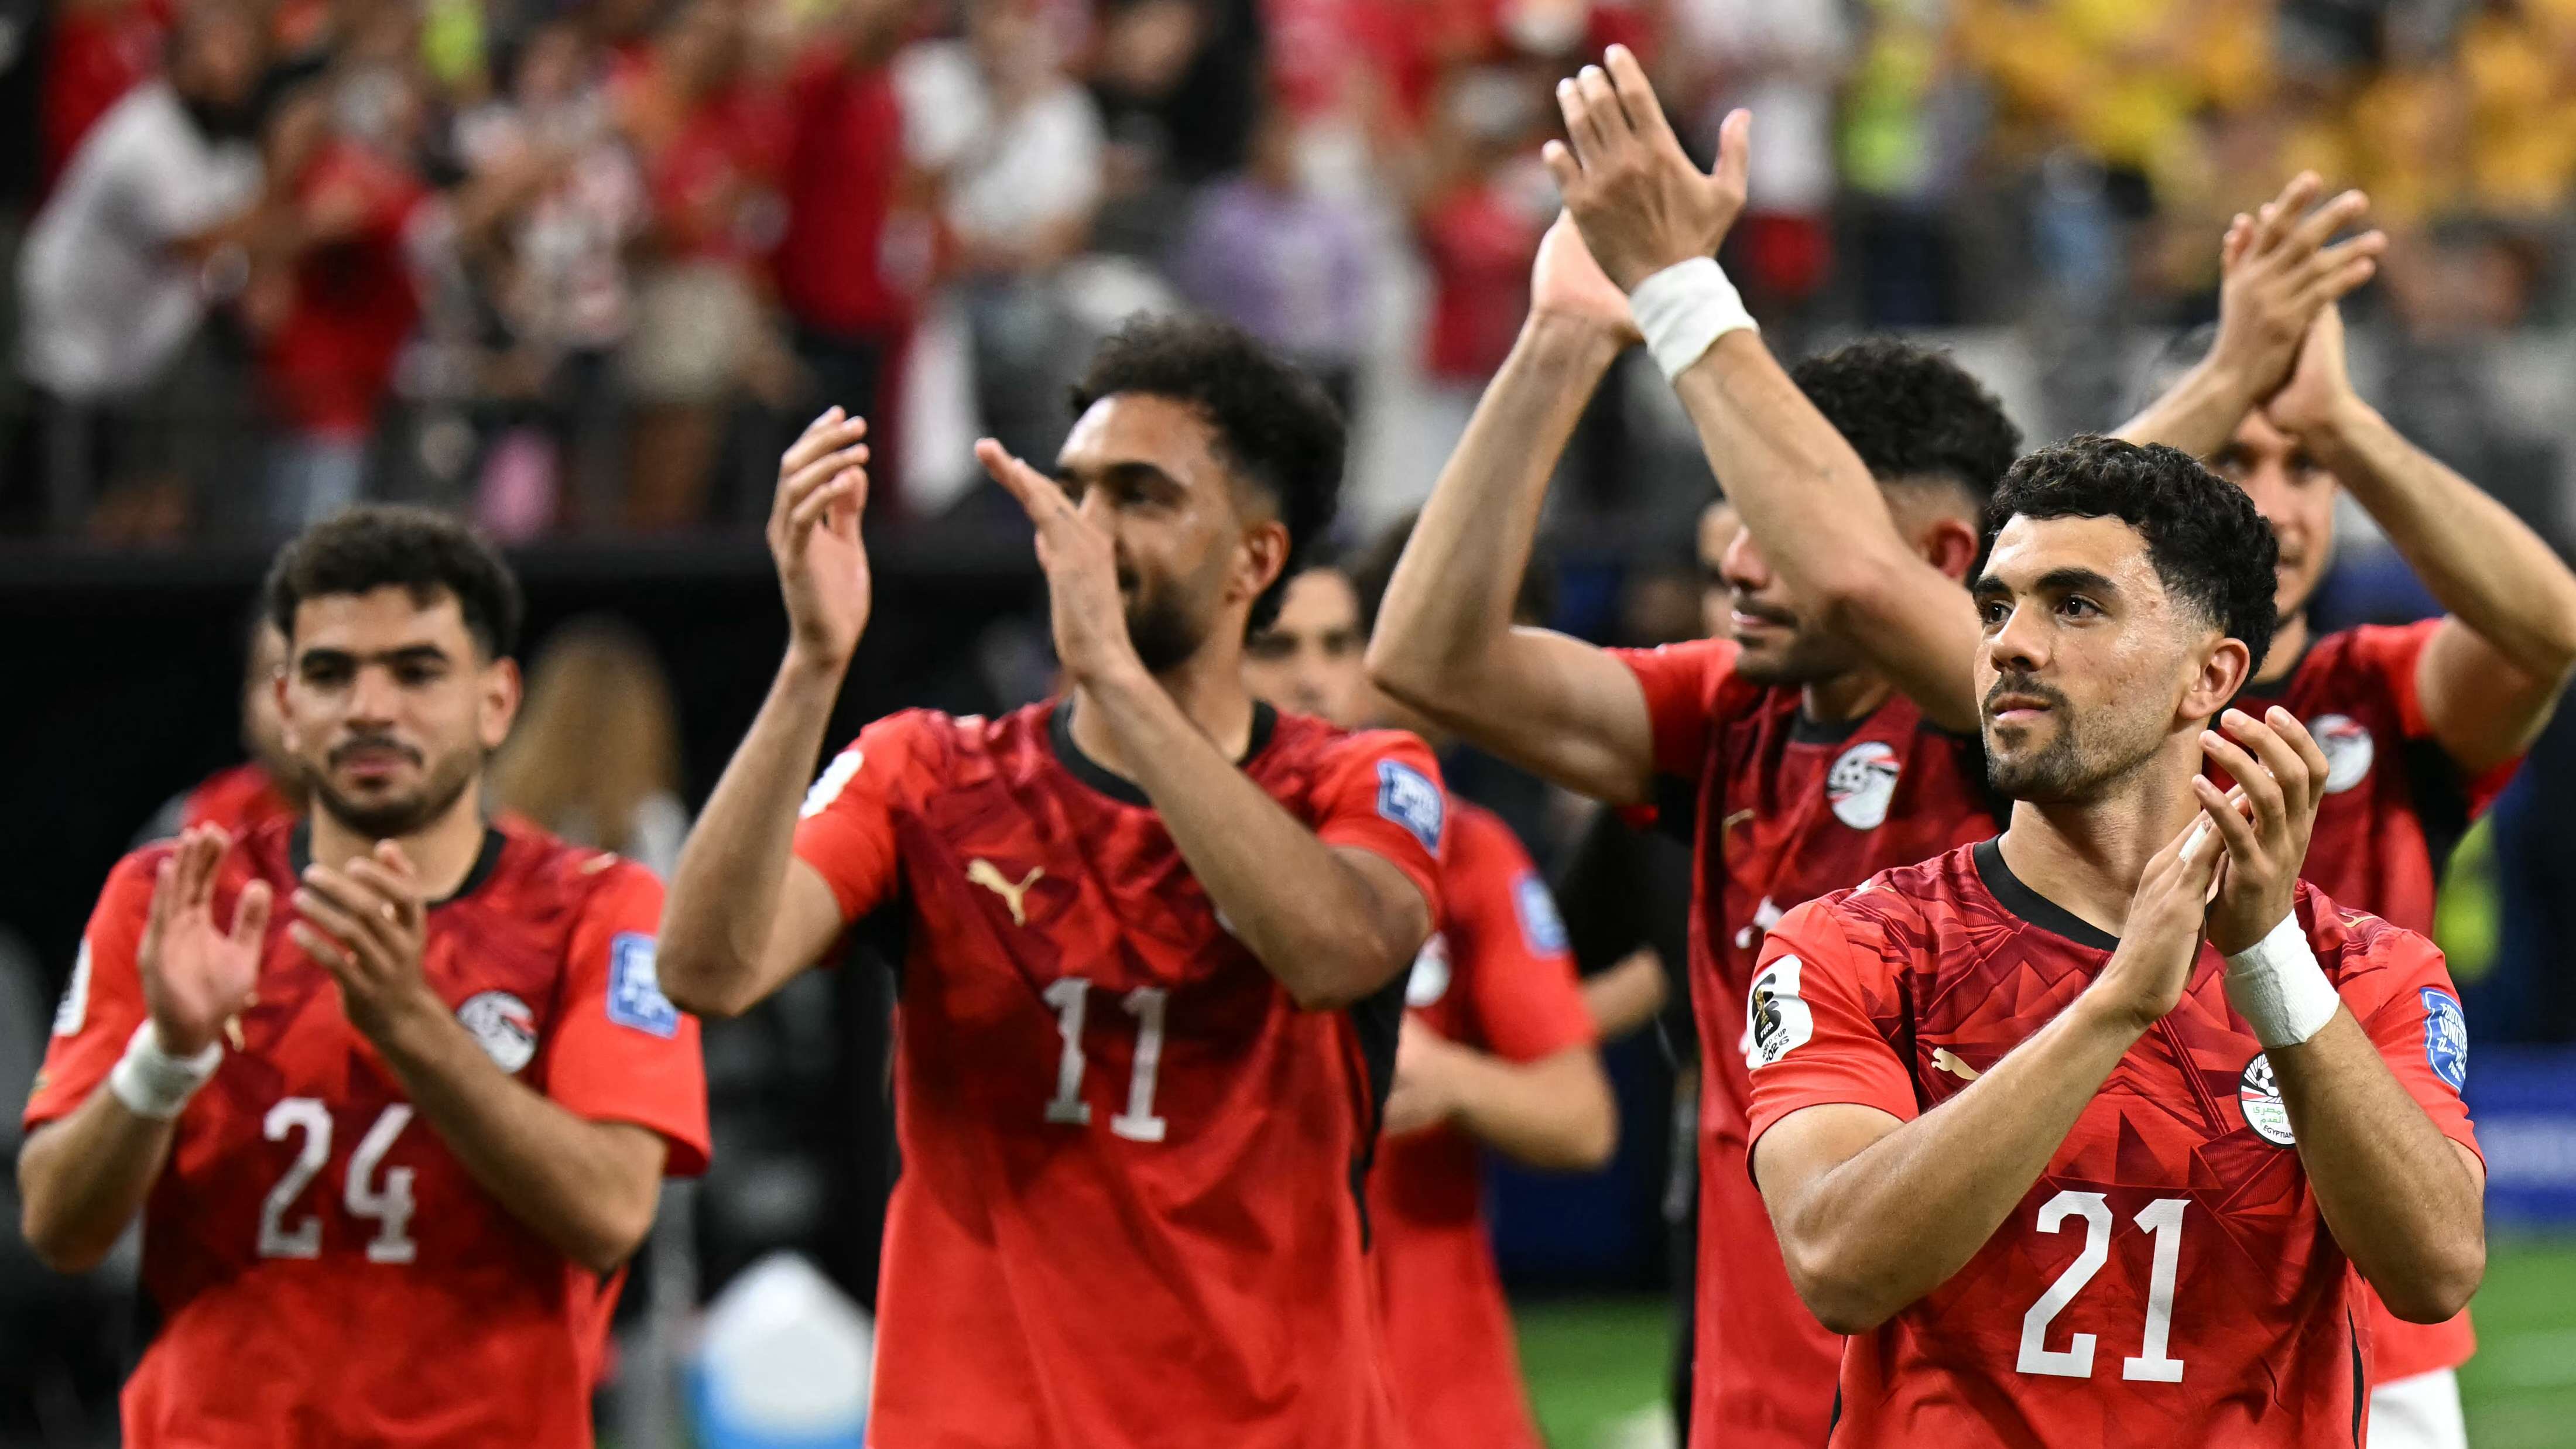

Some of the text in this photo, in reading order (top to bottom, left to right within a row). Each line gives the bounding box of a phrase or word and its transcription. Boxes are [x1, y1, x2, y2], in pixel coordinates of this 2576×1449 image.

[1042, 976, 1168, 1142] 11
[1760, 1021, 1774, 1039] FIFA
[1775, 1028, 1786, 1040] CUP
[259, 1097, 417, 1263] 24
[2016, 1190, 2192, 1382] 21
